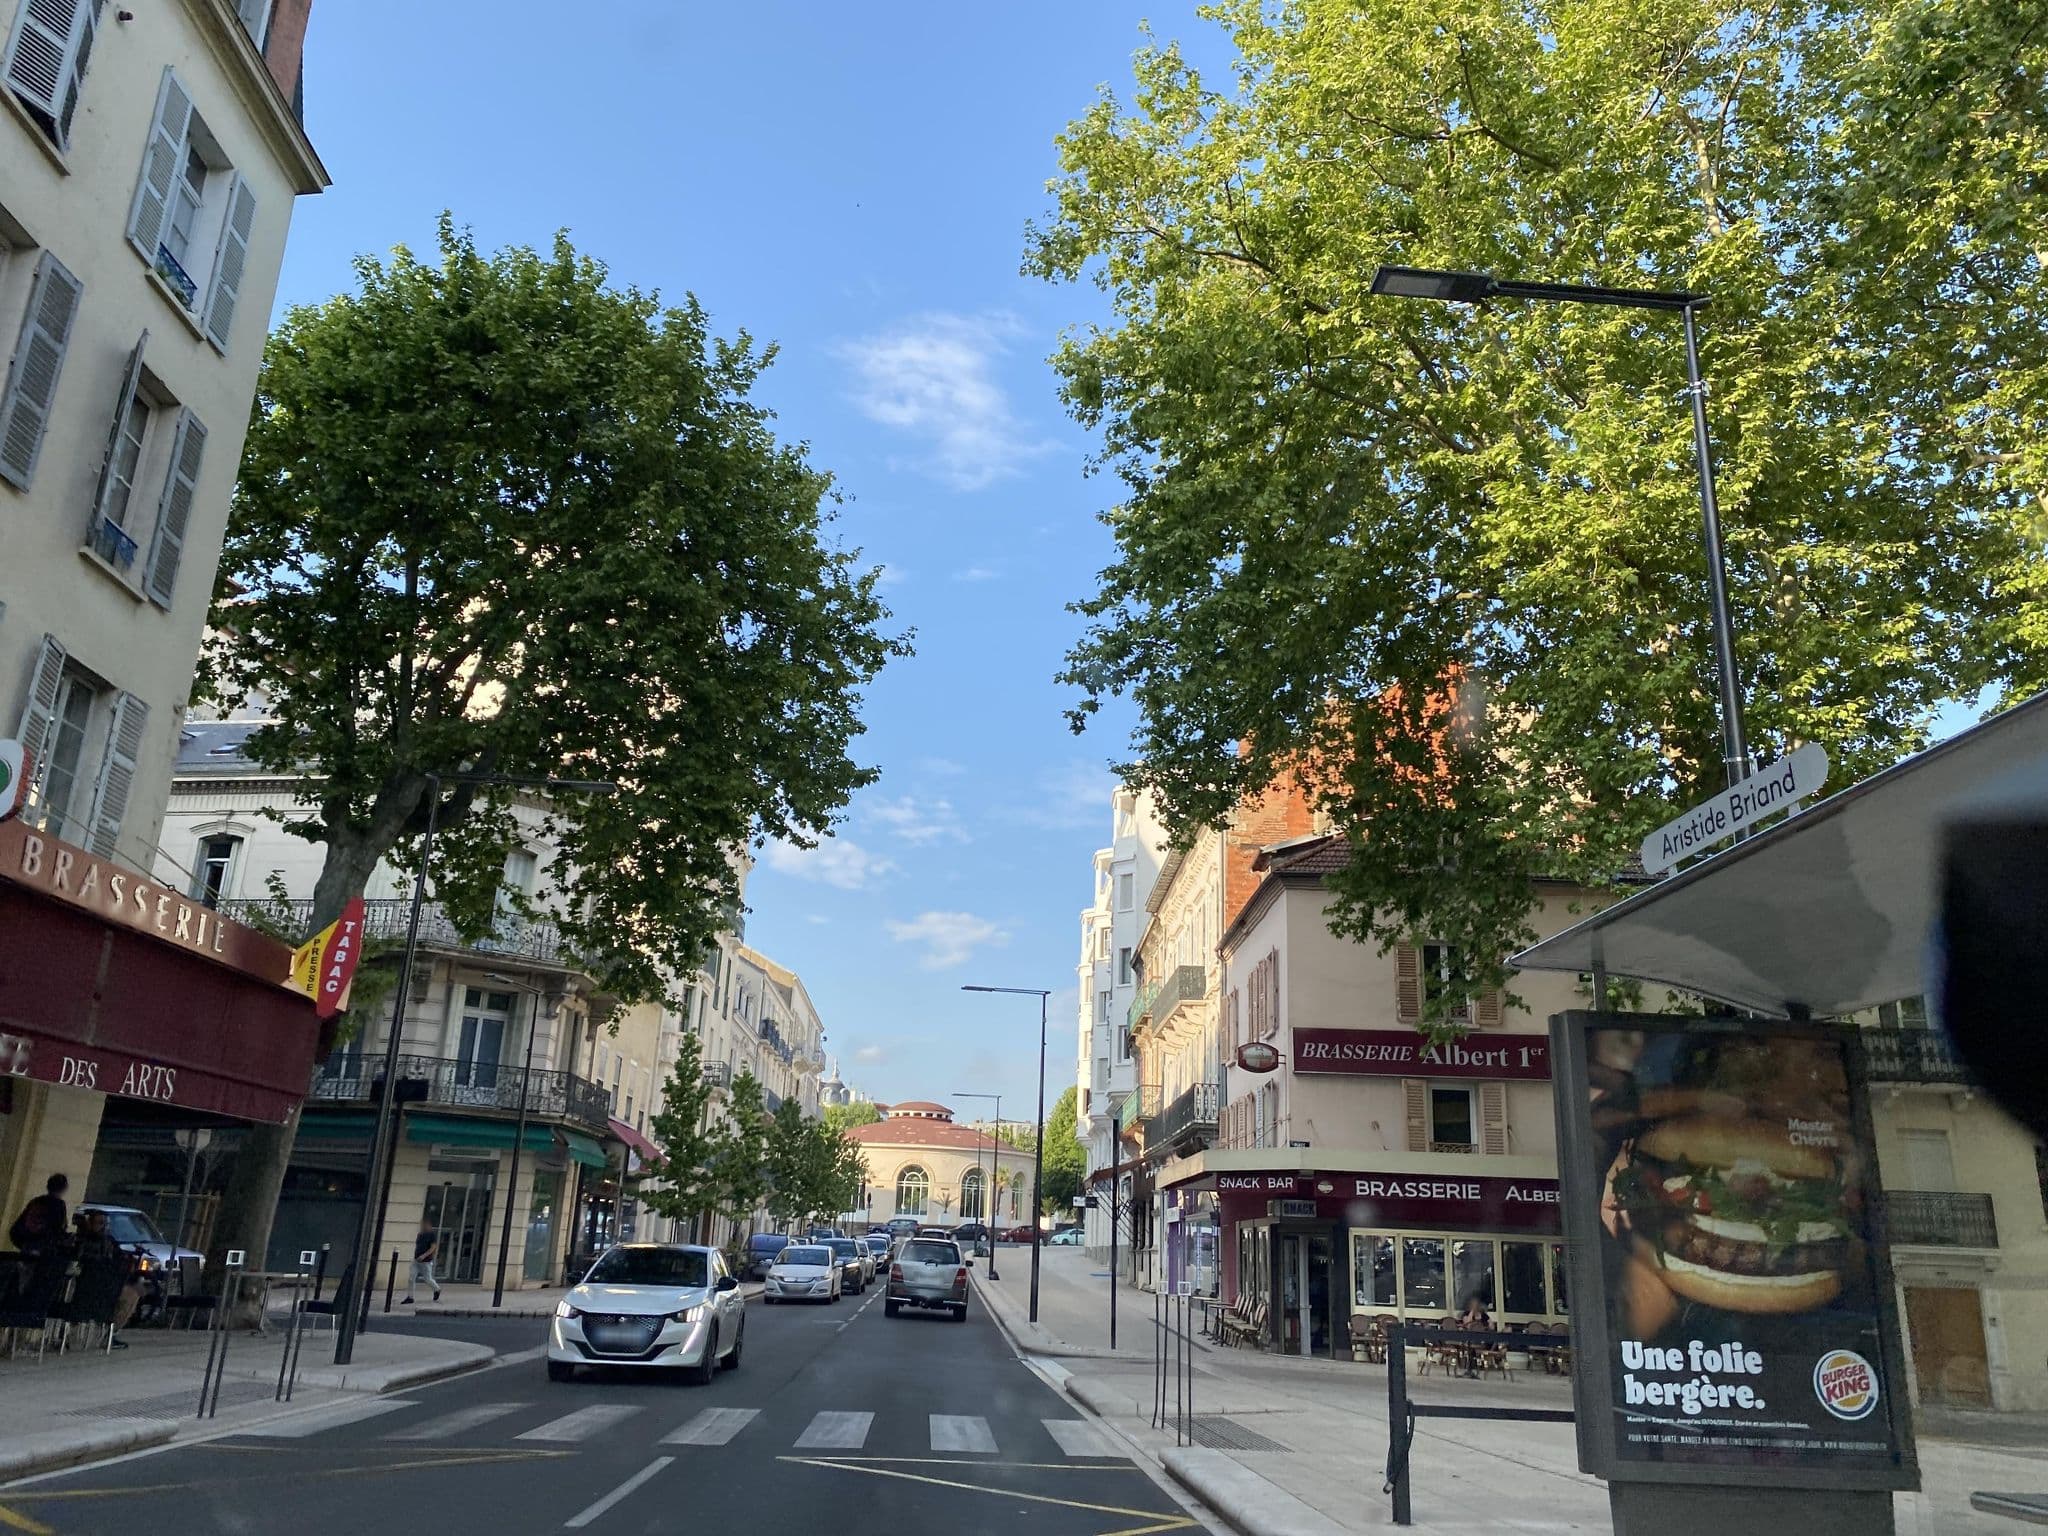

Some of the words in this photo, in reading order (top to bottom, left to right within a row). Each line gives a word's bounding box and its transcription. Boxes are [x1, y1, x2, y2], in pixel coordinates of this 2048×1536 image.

[1661, 806, 1725, 859] Aristide
[1729, 762, 1795, 822] Briand
[22, 834, 225, 953] BRASSERIE
[306, 938, 321, 992] PRESSE
[325, 921, 356, 992] TABAC
[1302, 1042, 1413, 1061] BRASSERIE
[1421, 1044, 1509, 1066] Albert
[1518, 1046, 1544, 1067] 1er
[60, 1056, 97, 1089] DES
[119, 1061, 176, 1100] ARTS
[1219, 1177, 1260, 1189] SNACK
[1267, 1177, 1294, 1189] BAR
[1355, 1180, 1481, 1199] BRASSERIE
[1621, 1340, 1684, 1371] Une
[1688, 1340, 1763, 1374] folie
[1821, 1364, 1867, 1386] BURGER
[1623, 1374, 1765, 1415] bergère.
[1825, 1375, 1870, 1403] KING
